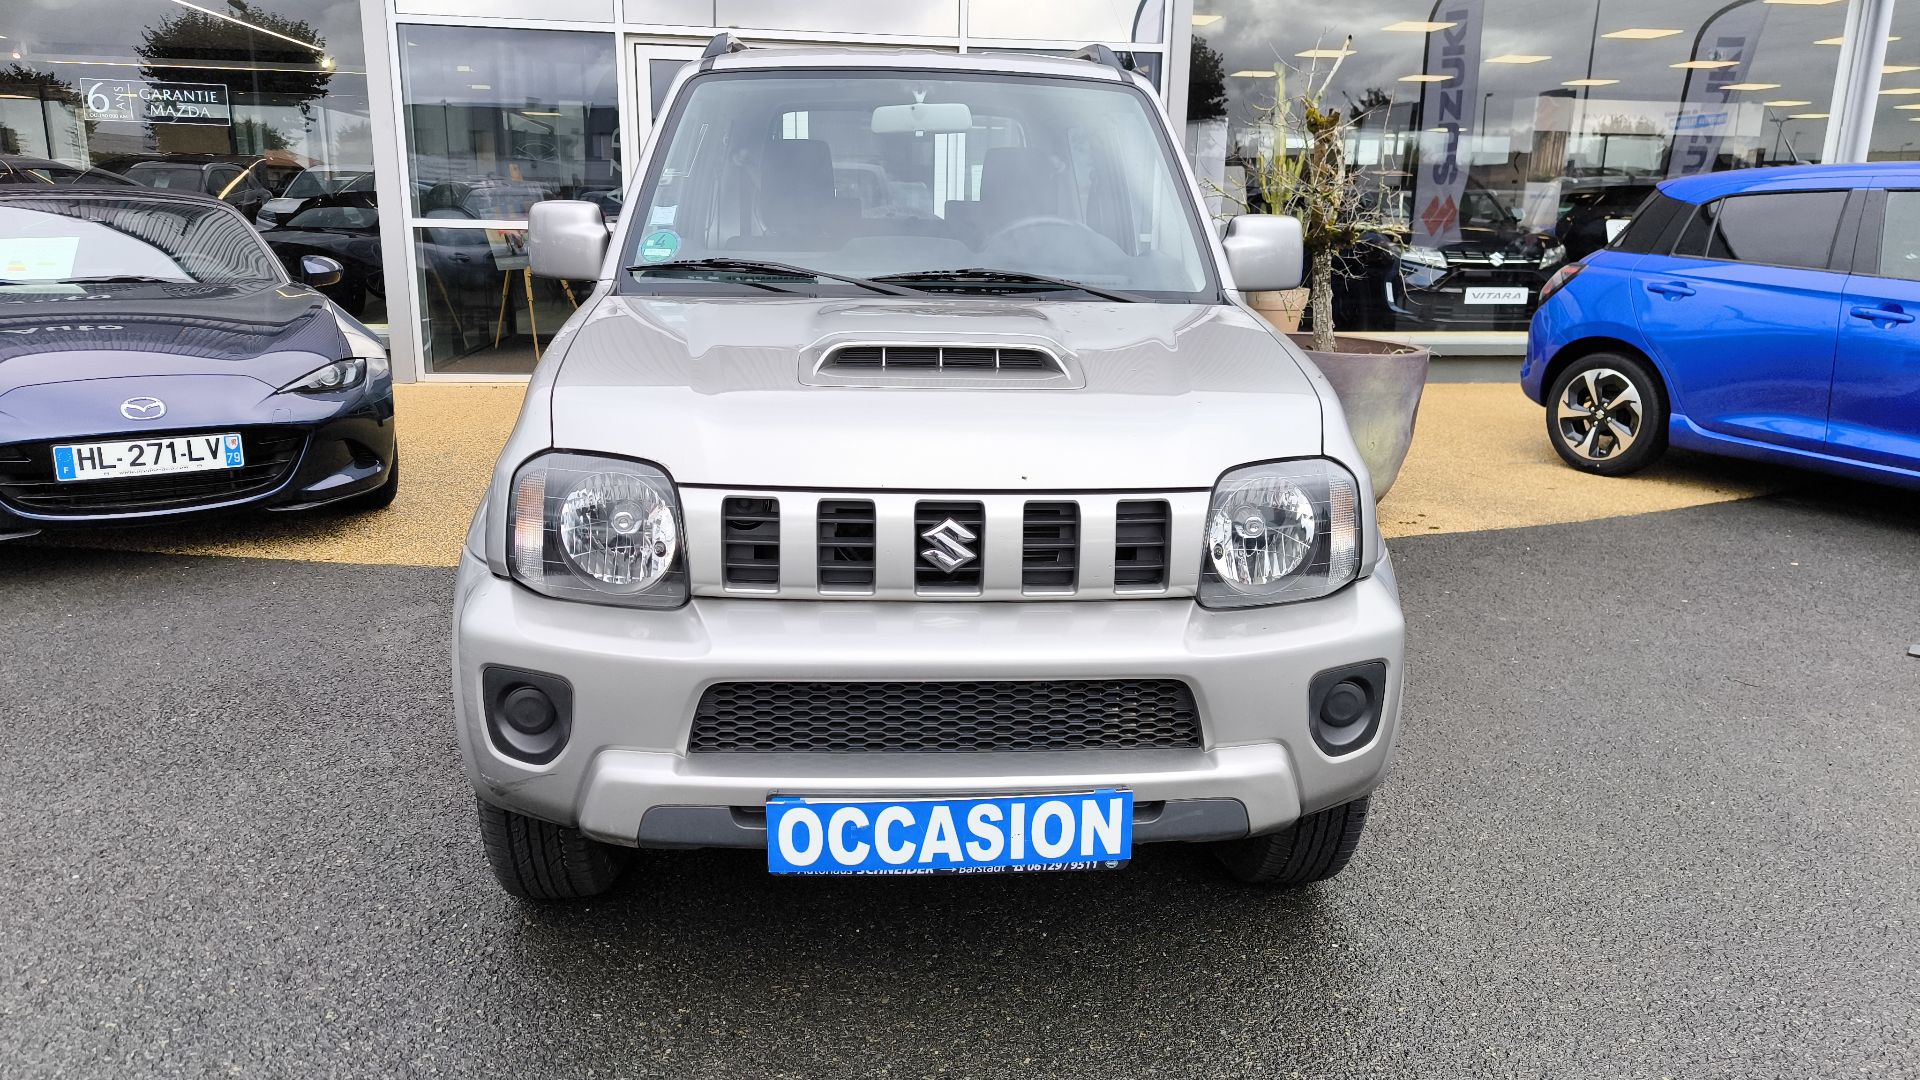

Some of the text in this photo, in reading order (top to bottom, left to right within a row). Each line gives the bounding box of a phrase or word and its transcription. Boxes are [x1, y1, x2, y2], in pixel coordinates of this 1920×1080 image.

[87, 82, 110, 113] 6
[113, 86, 127, 111] ANS
[138, 88, 219, 103] GARANTIE
[1433, 9, 1469, 186] SUZUKI
[150, 104, 211, 118] MAZDA
[1472, 292, 1521, 300] VITARA
[76, 437, 220, 471] HL-271-LV
[226, 452, 242, 463] 79
[777, 798, 1124, 867] OCCASION
